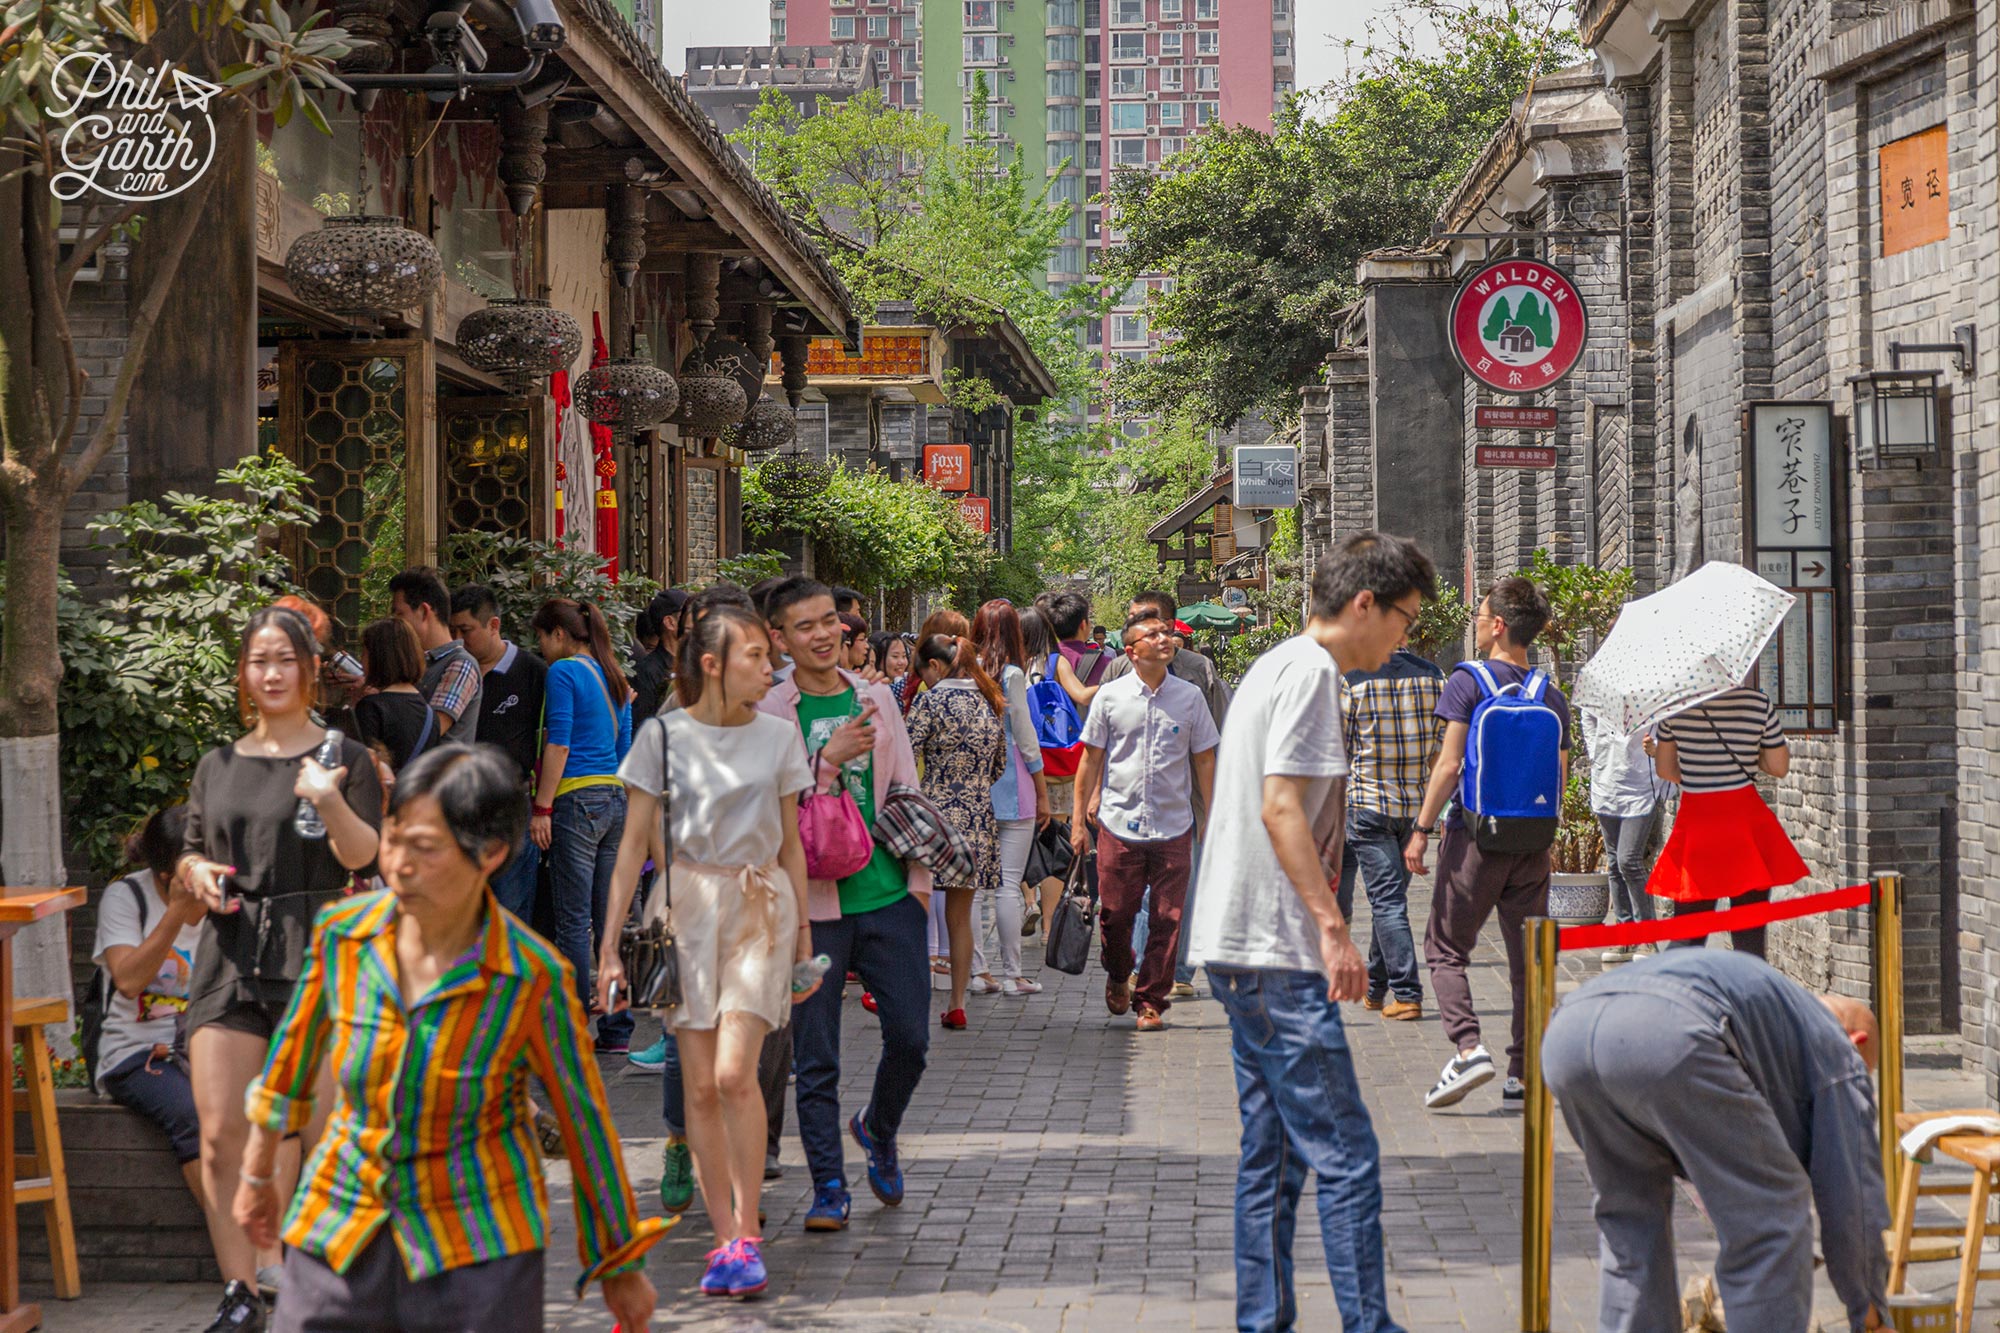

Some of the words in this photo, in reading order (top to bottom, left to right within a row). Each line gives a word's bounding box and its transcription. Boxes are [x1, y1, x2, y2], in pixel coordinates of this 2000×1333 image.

[1474, 267, 1569, 303] WALDEN
[1476, 356, 1556, 385] 瓦尔登
[1519, 411, 1549, 421] 音乐酒吧
[931, 452, 962, 475] foxy
[1239, 458, 1294, 477] 白夜
[1239, 477, 1266, 486] White
[1267, 477, 1293, 488] Night
[1776, 417, 1808, 534] 窄巷子
[961, 504, 984, 521] foxy
